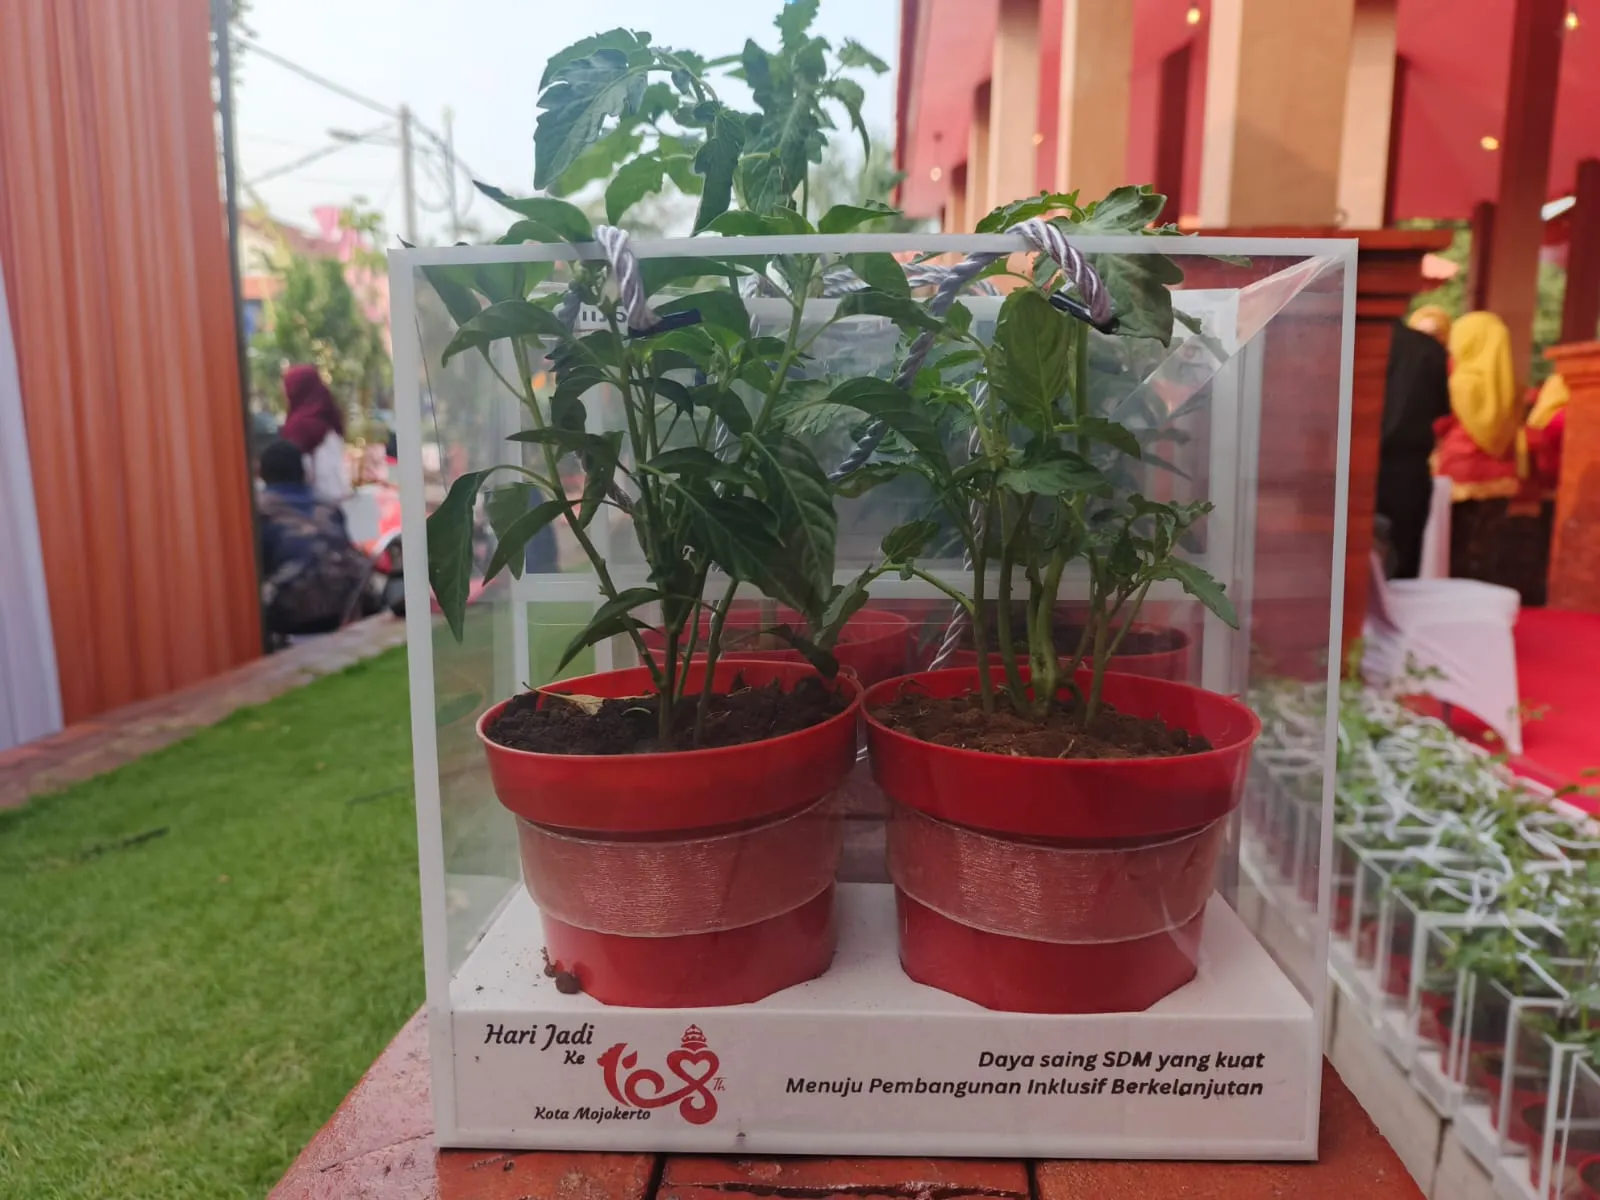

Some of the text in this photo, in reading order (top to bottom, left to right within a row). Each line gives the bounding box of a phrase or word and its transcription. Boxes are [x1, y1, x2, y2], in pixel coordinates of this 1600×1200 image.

[484, 1022, 594, 1050] Hari Jadi
[564, 1050, 586, 1065] Ke
[978, 1051, 1266, 1072] Daya saing SDM yang kuat
[785, 1077, 1264, 1100] Menuju Pembangunan Inklusif Berkelanjutan
[534, 1106, 651, 1124] Kota Mojokerto
